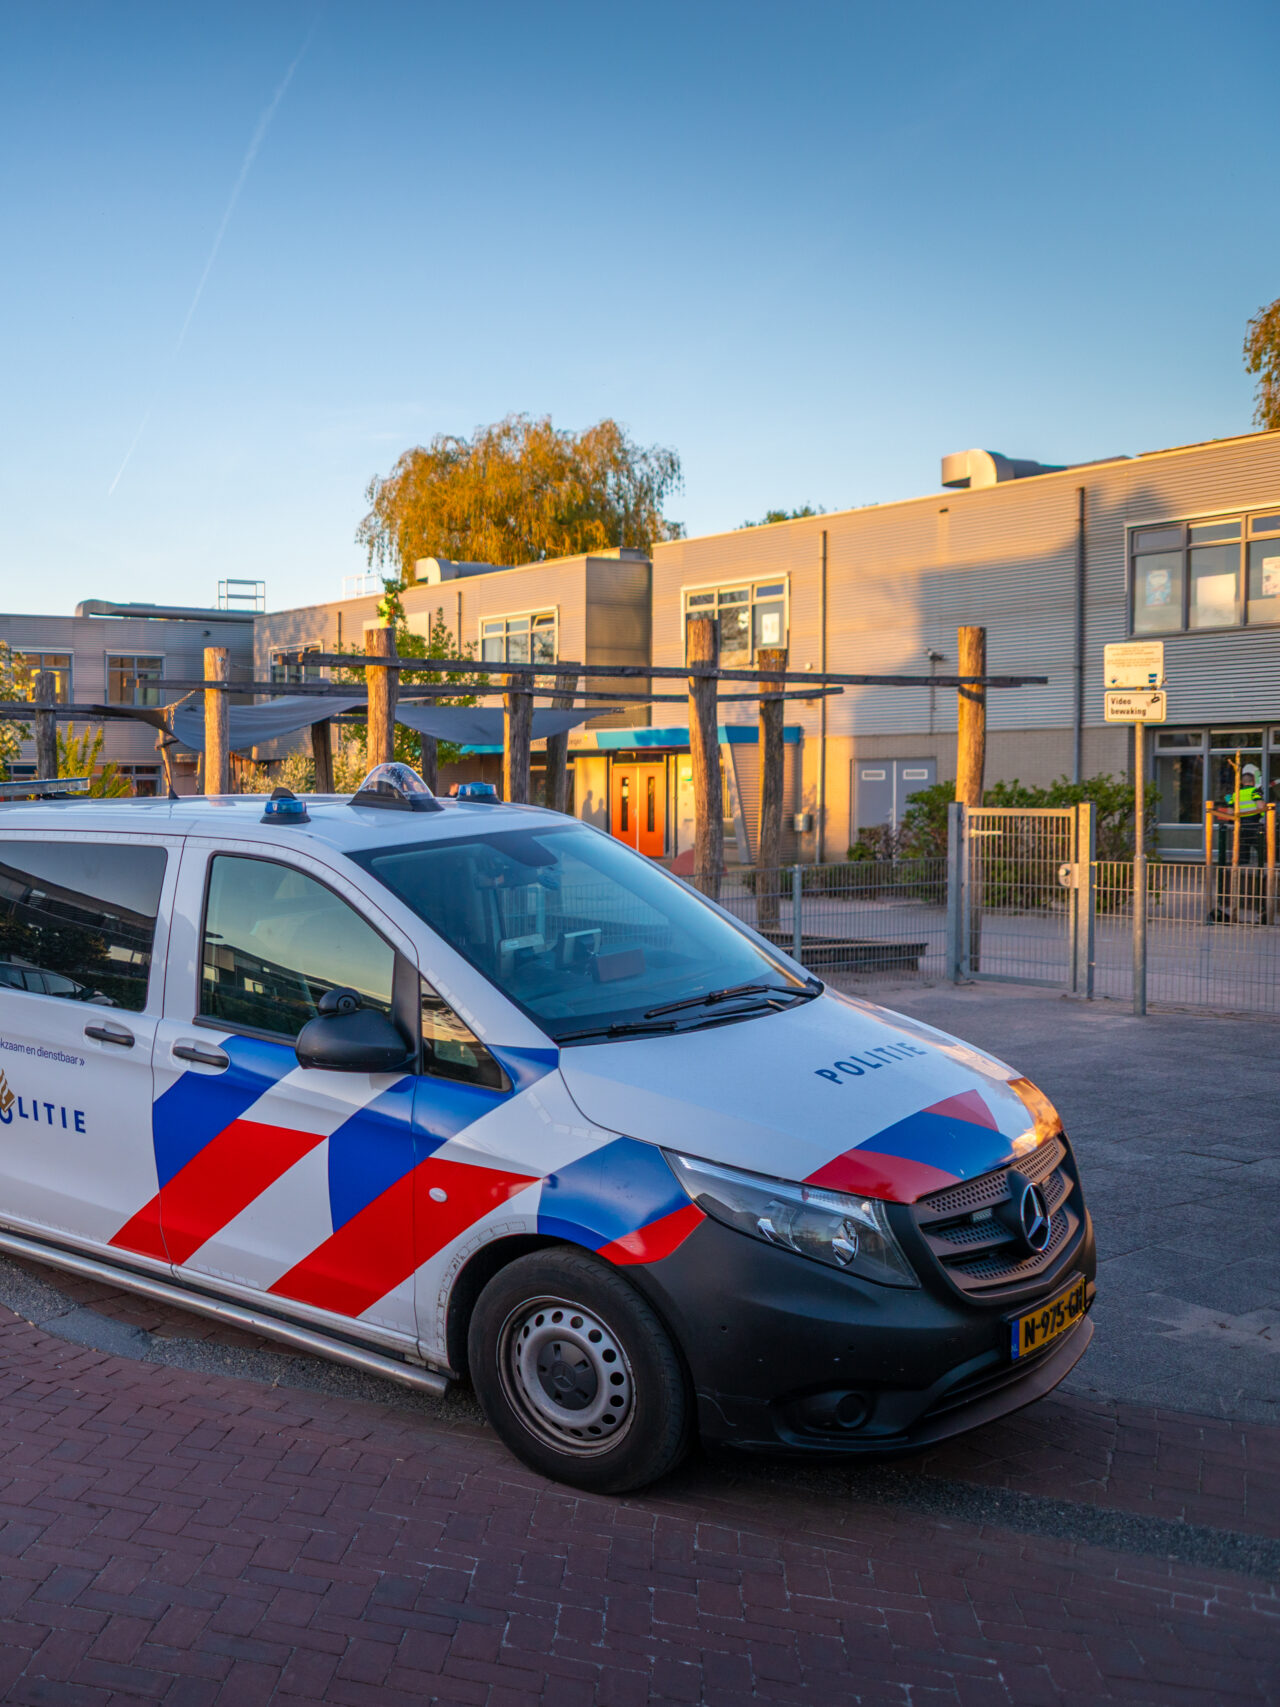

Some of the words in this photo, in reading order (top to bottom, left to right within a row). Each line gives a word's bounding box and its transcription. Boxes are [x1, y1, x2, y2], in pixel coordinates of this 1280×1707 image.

[1111, 696, 1132, 705] Video
[1110, 707, 1147, 718] bewaking
[25, 1046, 36, 1056] en
[37, 1046, 78, 1065] dienstbaar
[814, 1042, 928, 1085] POLITIE
